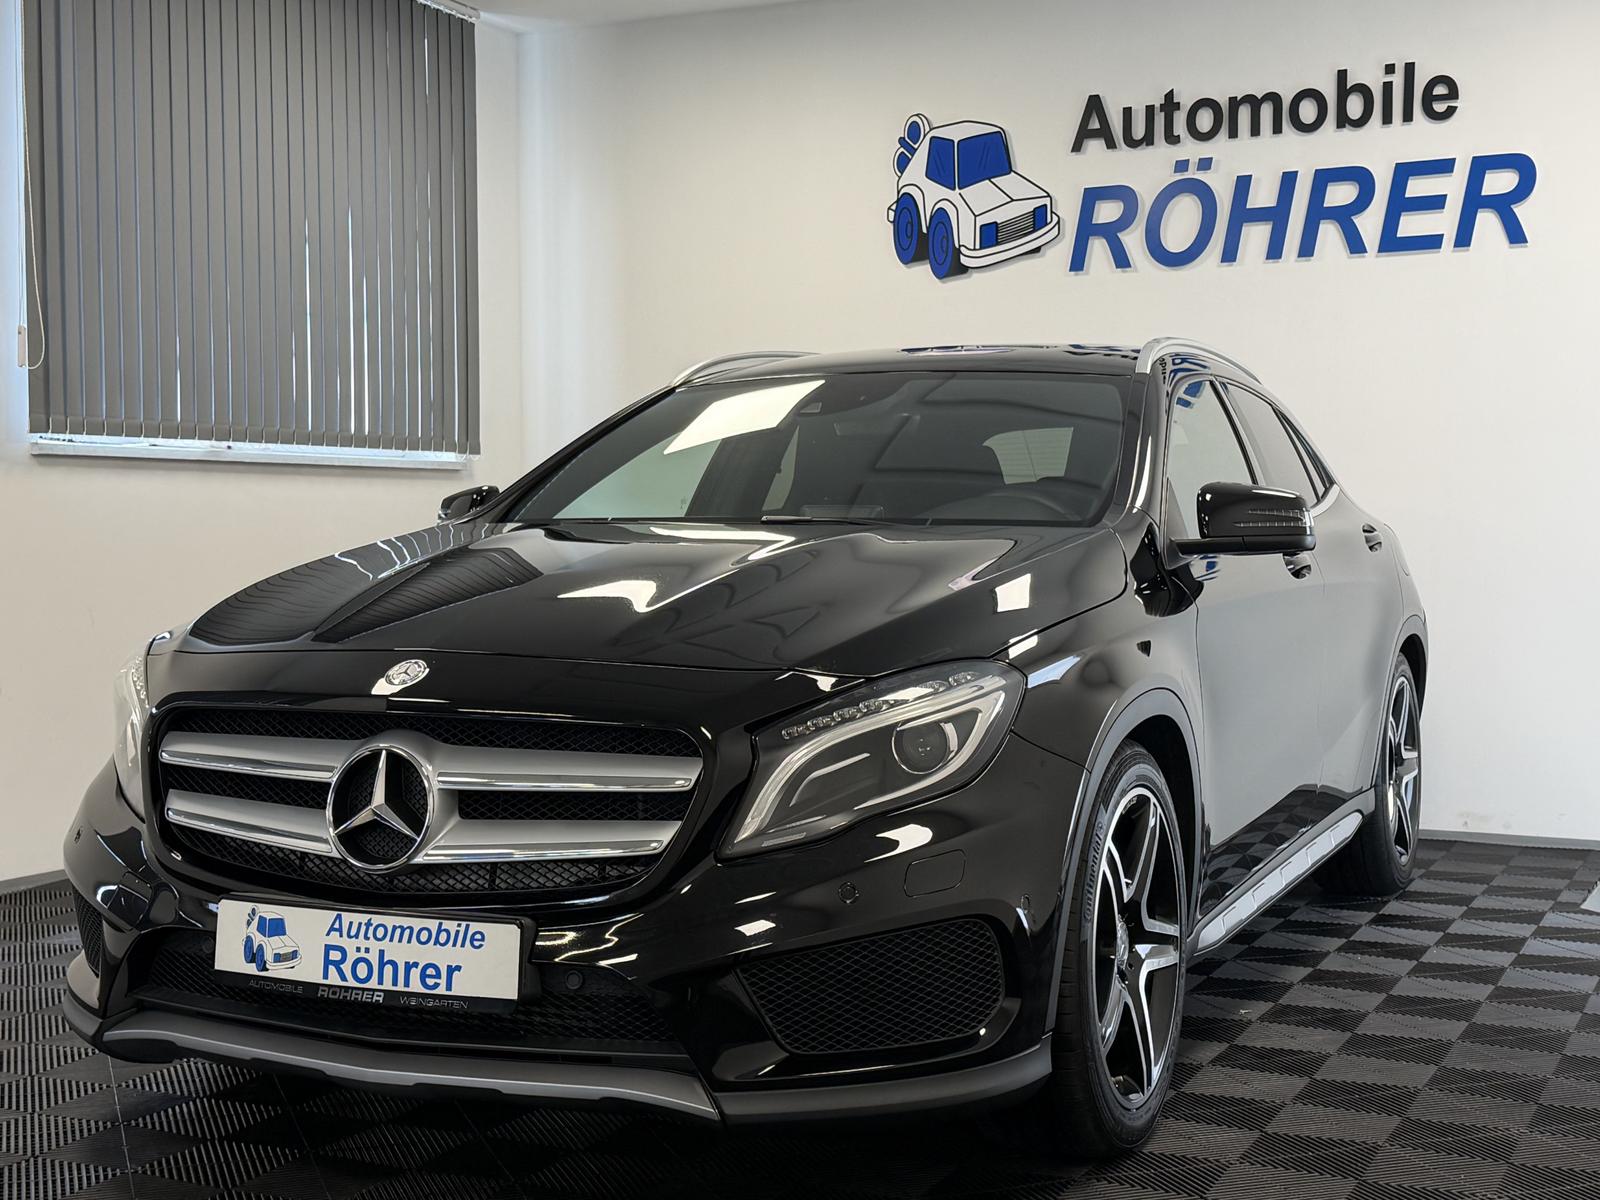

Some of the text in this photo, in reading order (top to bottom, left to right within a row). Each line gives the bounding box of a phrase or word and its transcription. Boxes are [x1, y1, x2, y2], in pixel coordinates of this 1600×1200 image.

[1071, 62, 1460, 153] Automobile
[1069, 154, 1537, 273] RÖHRER
[325, 913, 486, 949] Automobile
[322, 943, 462, 992] Röhrer
[249, 979, 304, 994] AUTOMOBILE
[399, 996, 469, 1009] WEINGARTEN
